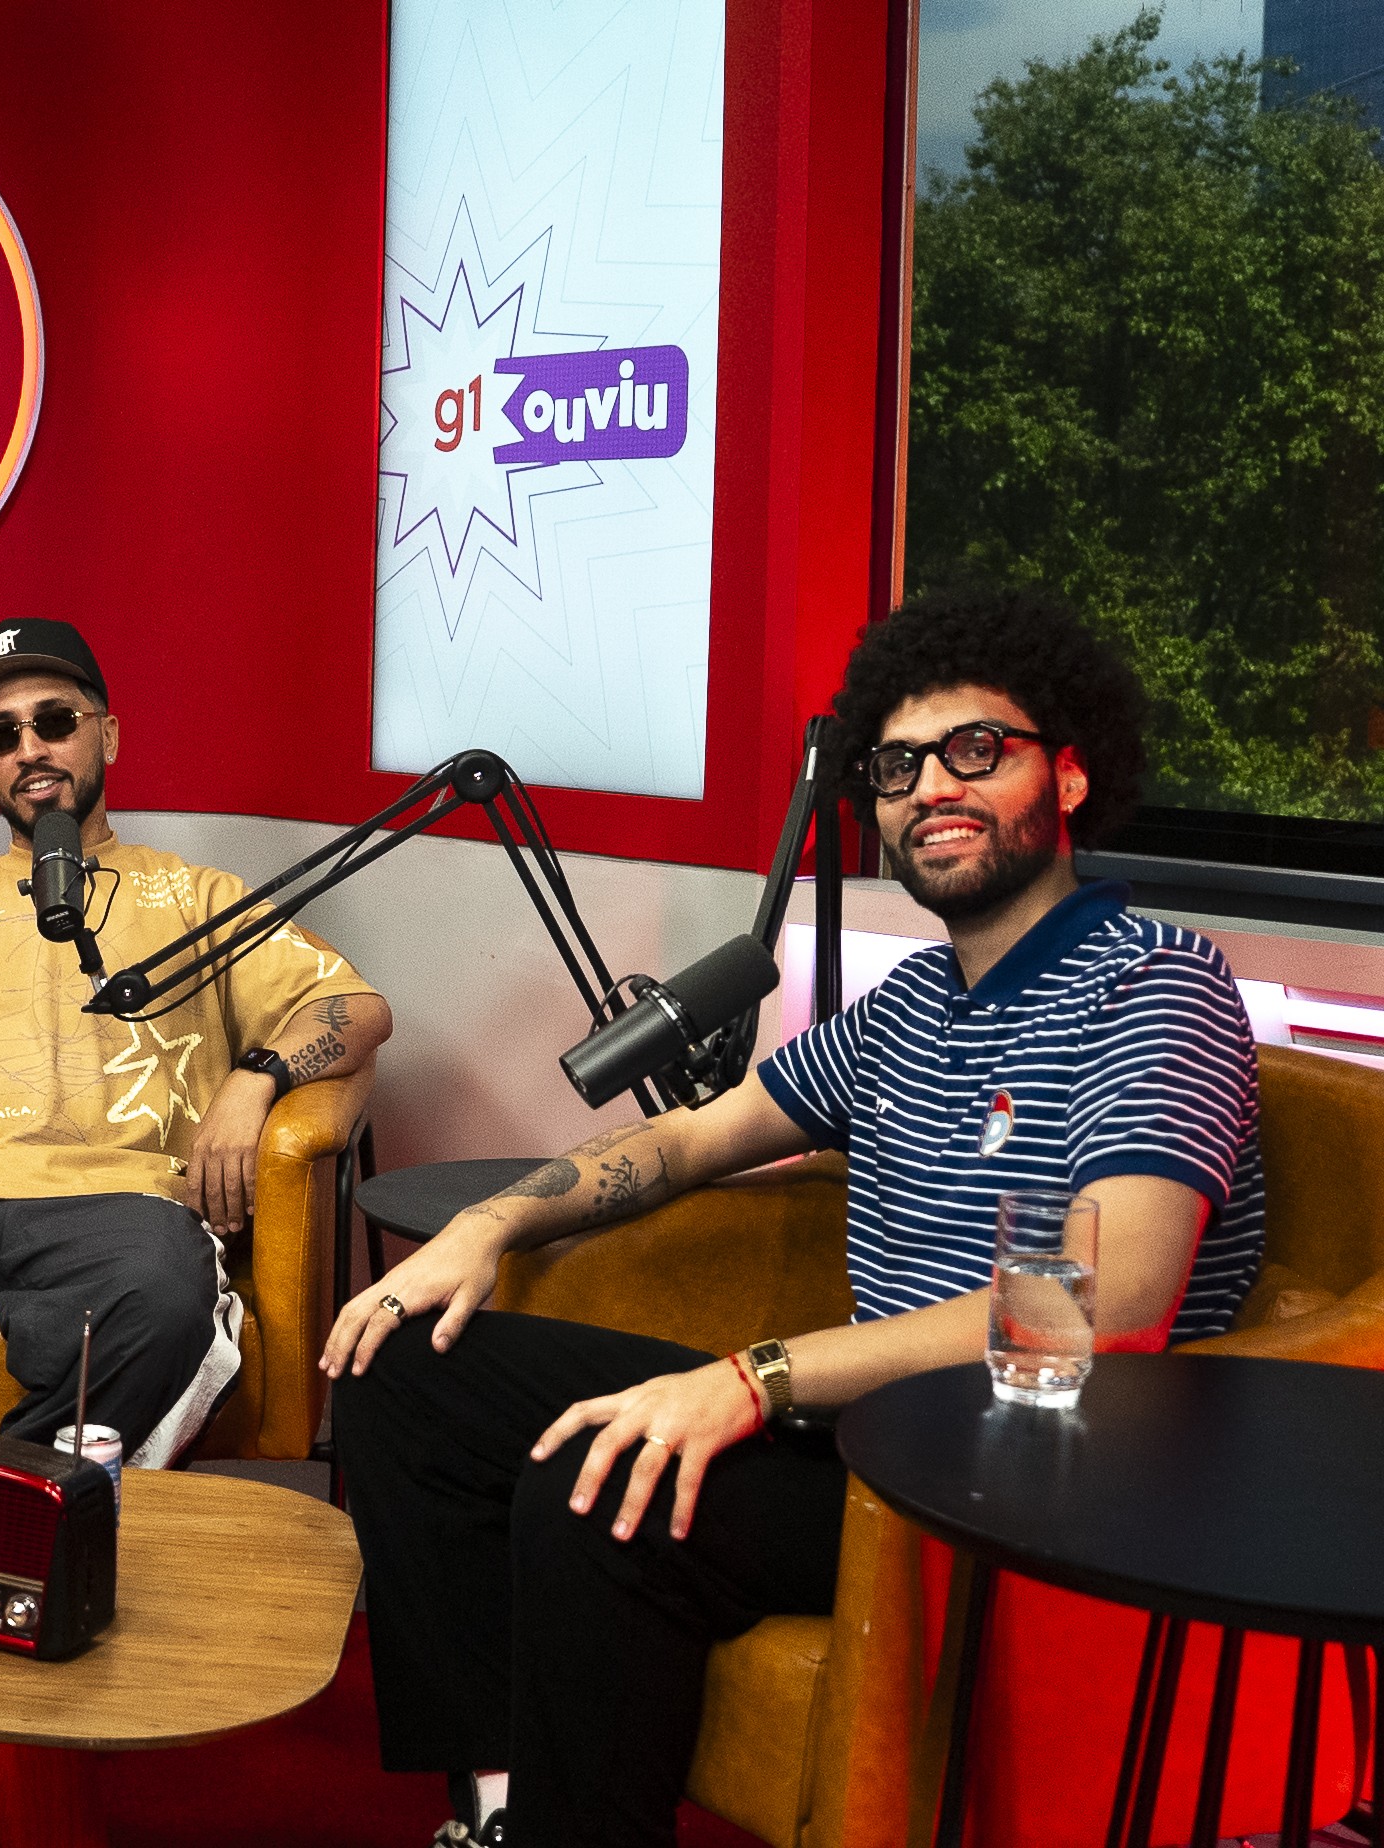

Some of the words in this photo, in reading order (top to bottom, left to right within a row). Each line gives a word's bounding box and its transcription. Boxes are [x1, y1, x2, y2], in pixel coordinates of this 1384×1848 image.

[434, 374, 482, 453] g1
[522, 358, 669, 444] ouviu
[316, 1031, 336, 1050] NA
